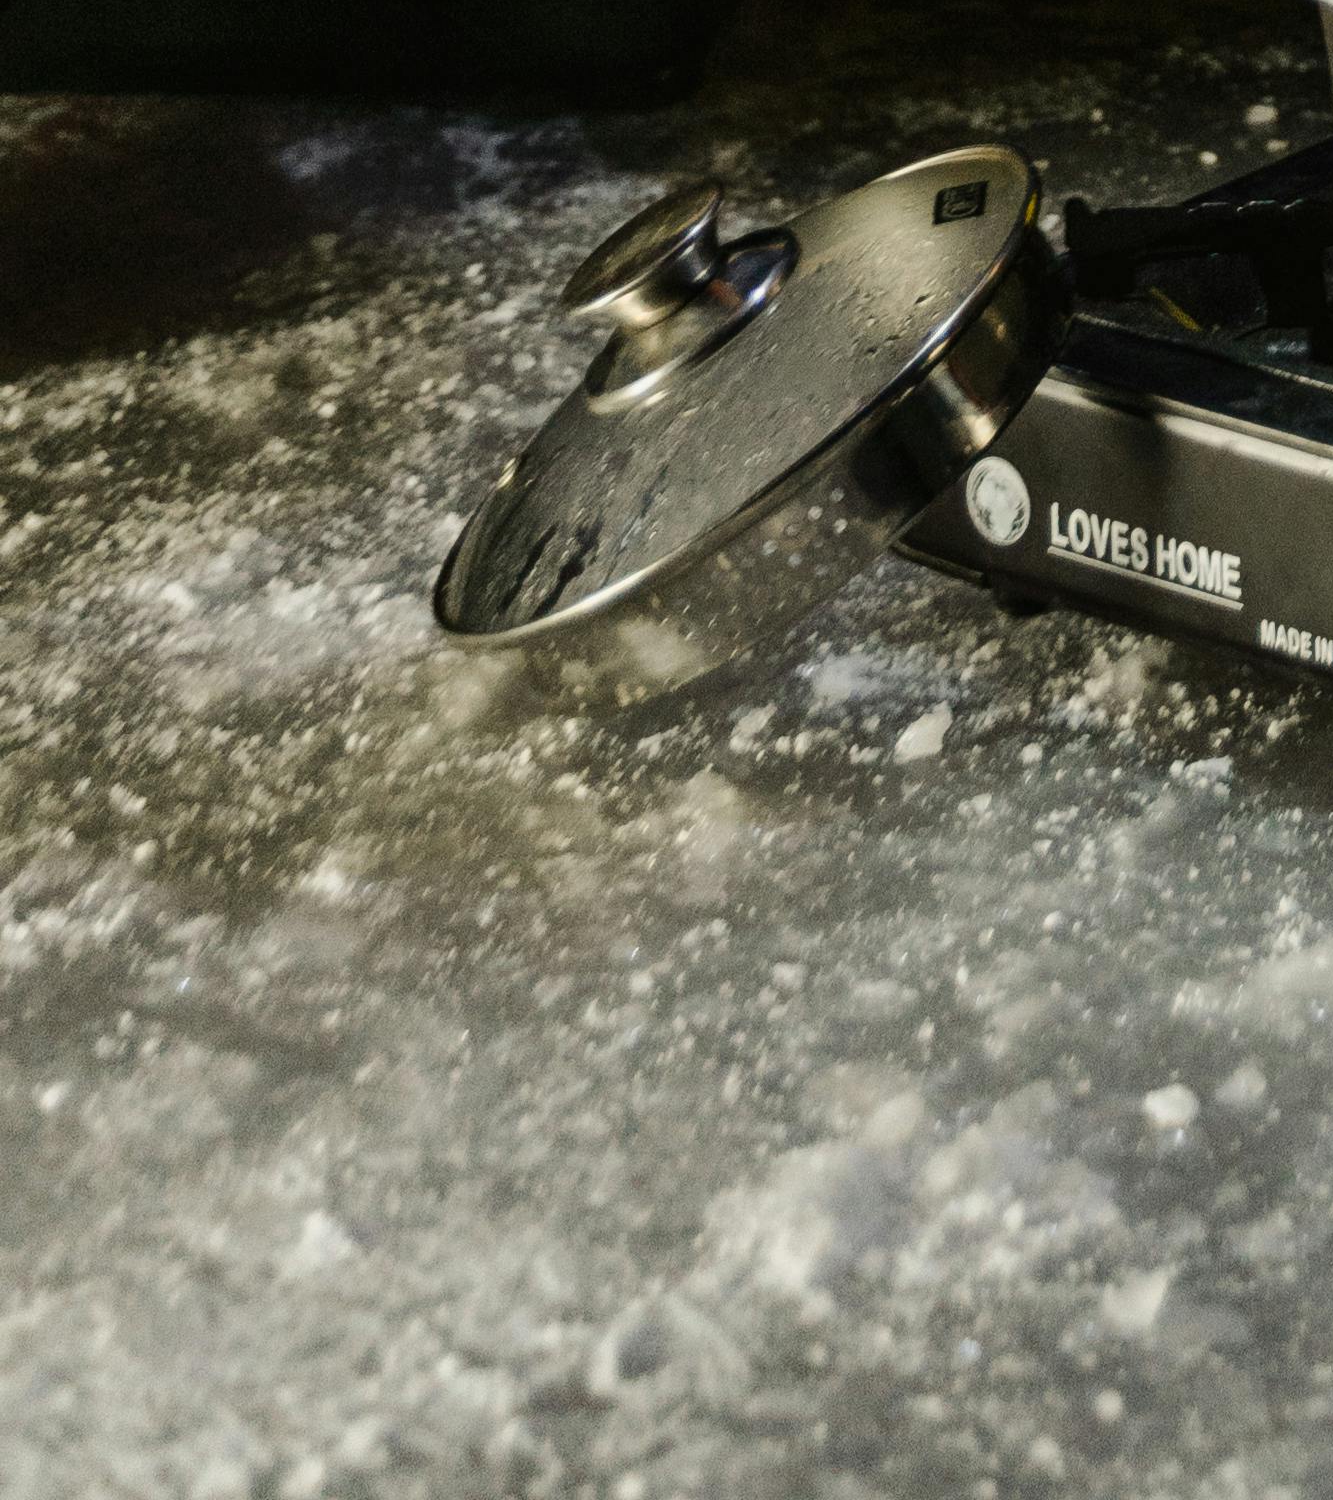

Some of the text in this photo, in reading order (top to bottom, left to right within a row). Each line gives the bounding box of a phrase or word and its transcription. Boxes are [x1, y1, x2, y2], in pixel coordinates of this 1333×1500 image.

[1050, 502, 1242, 600] LOVES HOME
[1260, 619, 1313, 660] MADE
[1313, 635, 1333, 667] IN
